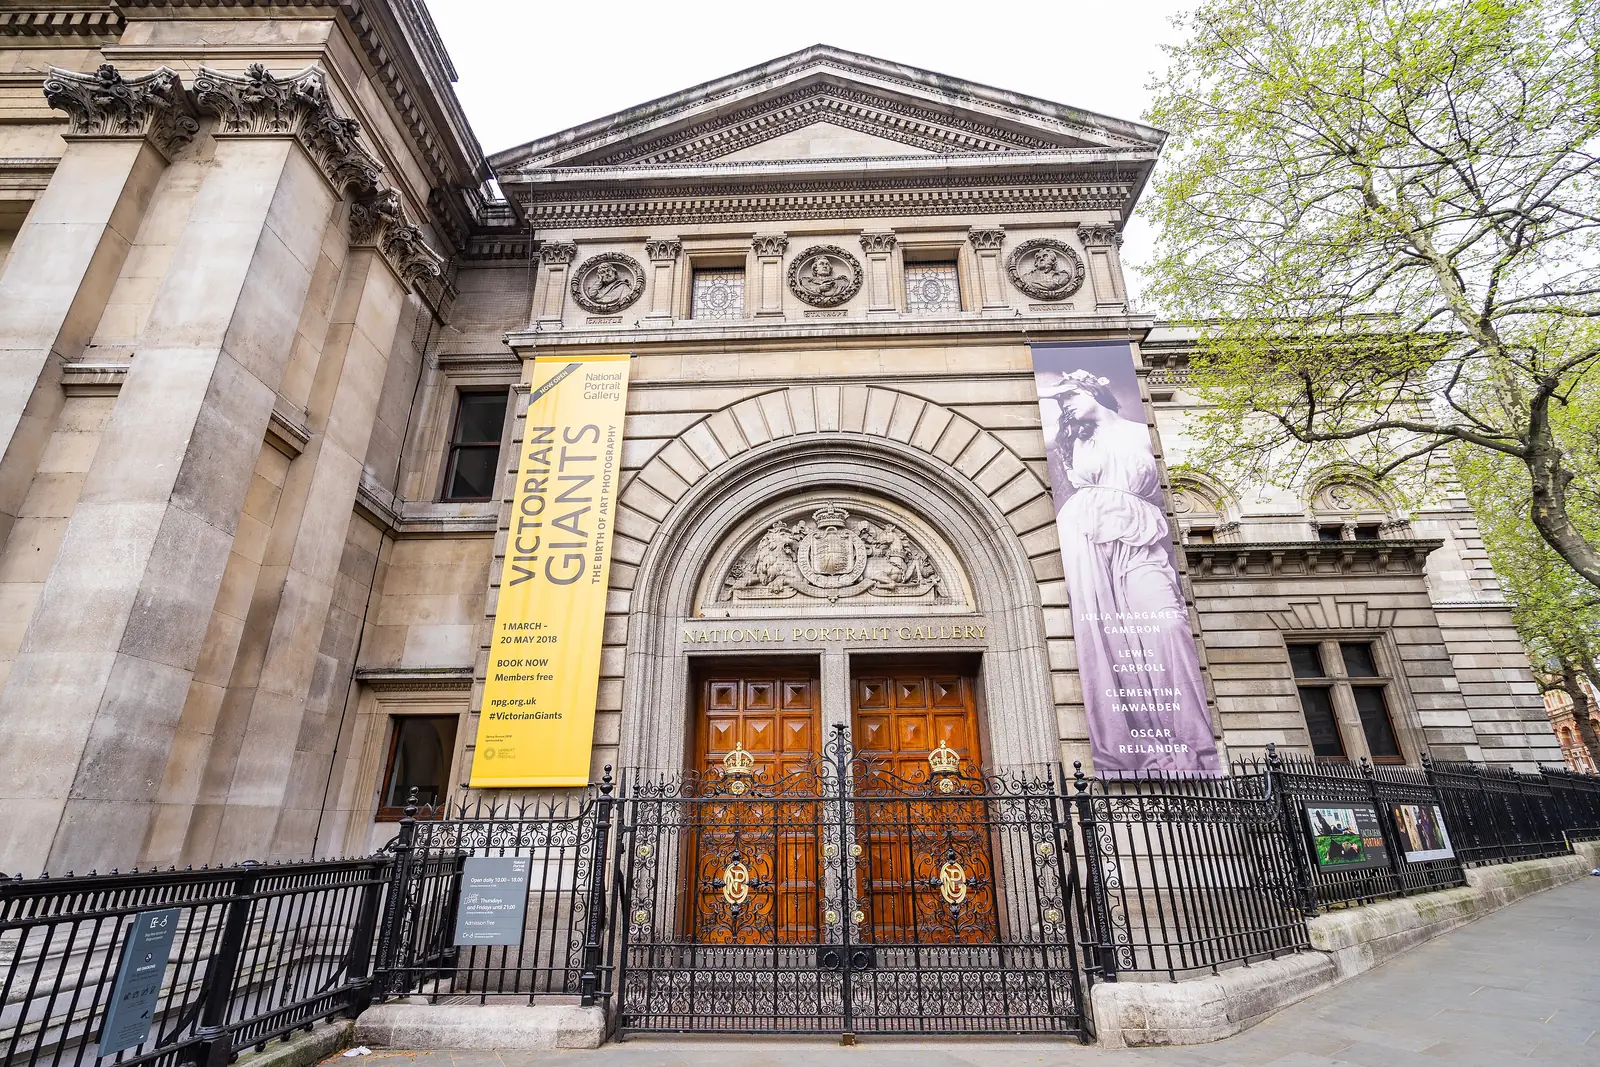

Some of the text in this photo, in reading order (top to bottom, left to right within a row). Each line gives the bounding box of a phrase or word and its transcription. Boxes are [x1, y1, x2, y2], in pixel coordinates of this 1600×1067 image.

[585, 372, 622, 381] National
[539, 370, 568, 395] NOW OPEN
[584, 381, 621, 390] Portrait
[583, 391, 620, 401] Gallery
[509, 426, 556, 587] VICTORIAN
[544, 423, 601, 586] GIANTS
[591, 424, 617, 584] THE BIRTH OF ART PHOTOGRAPHY
[1080, 611, 1179, 622] JULIA MARGARET
[508, 622, 542, 631] MARCH
[1103, 625, 1161, 634] CAMERON
[682, 625, 987, 643] NATIONAL PORTRAIT GALLERY
[500, 635, 558, 644] 20 MAY 2018
[1118, 649, 1154, 658] LEWIS
[497, 658, 549, 667] BOOK NOW
[1112, 663, 1166, 673] CARROLL
[494, 672, 554, 681] Members free
[1105, 687, 1182, 697] CLEMENTINA
[491, 697, 537, 707] npg.org.uk
[1111, 702, 1181, 712] HAWARDEN
[489, 711, 563, 720] #VictorianGiants
[1130, 728, 1172, 738] OSCAR
[1119, 744, 1189, 754] REJLANDER
